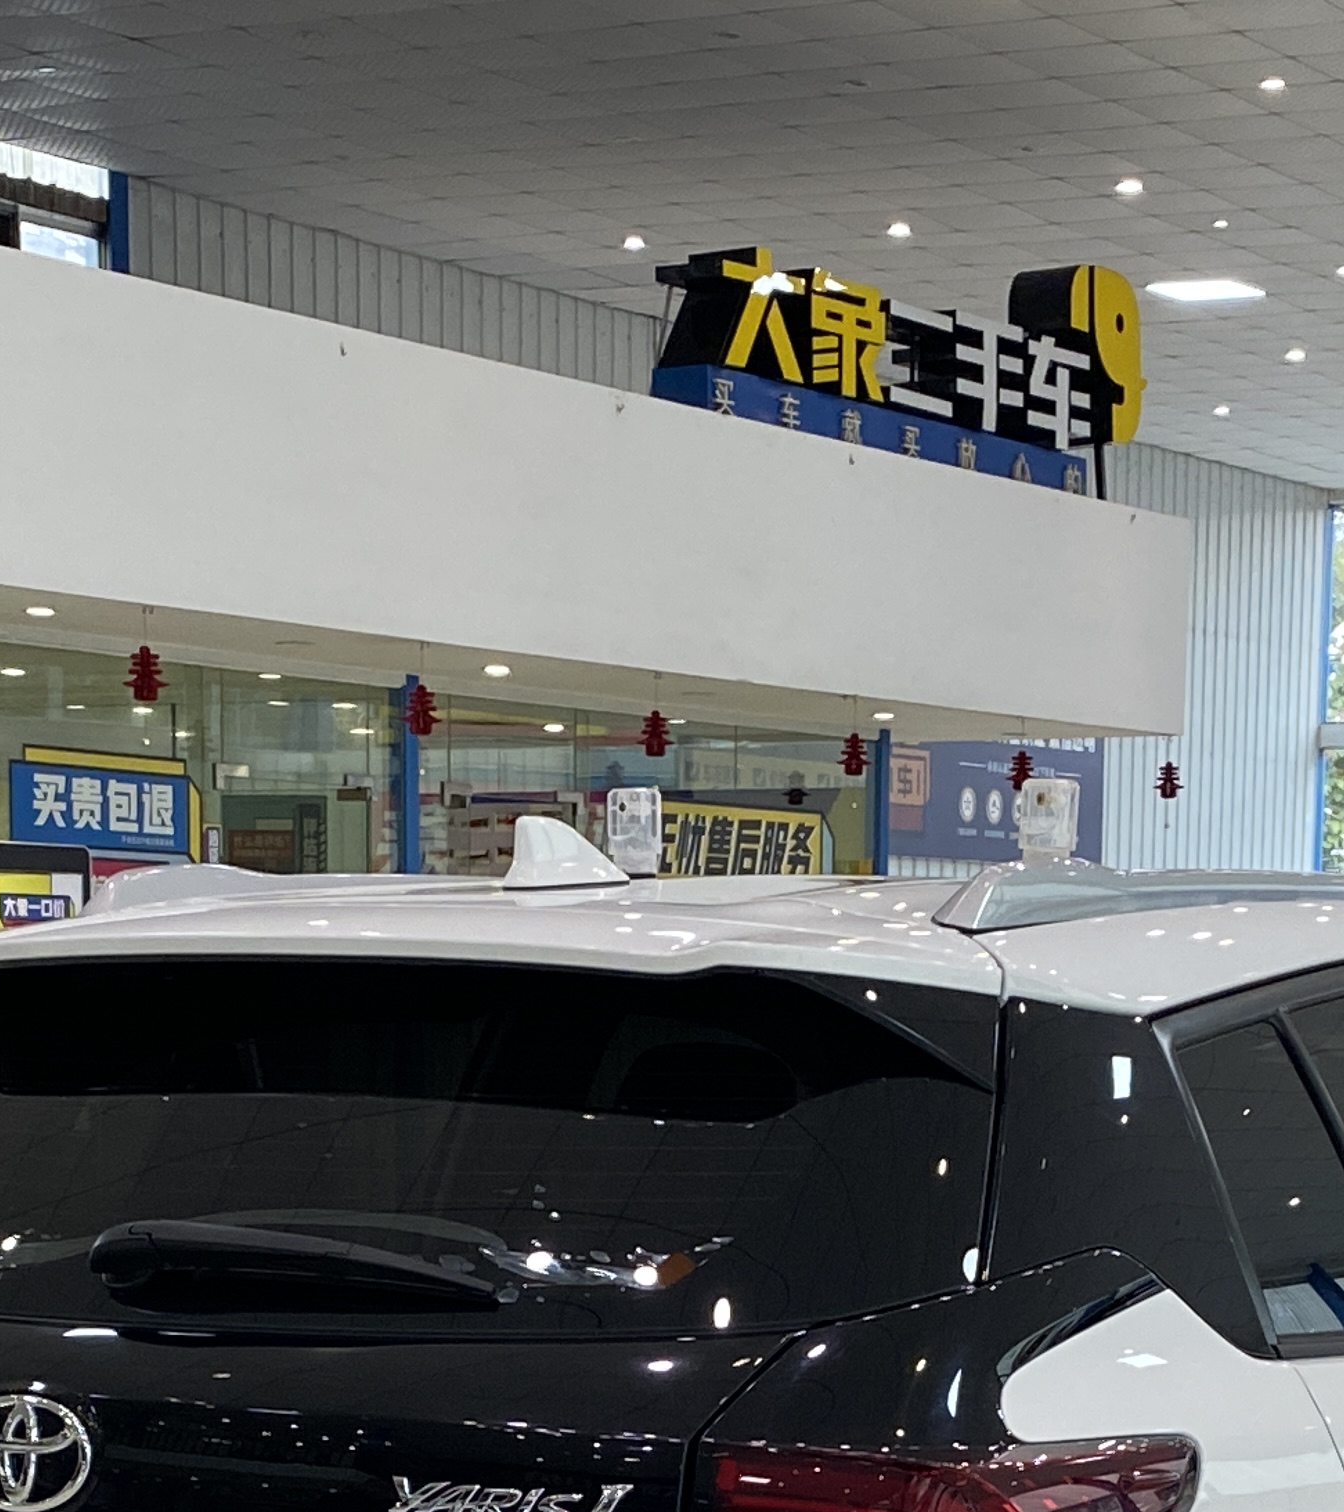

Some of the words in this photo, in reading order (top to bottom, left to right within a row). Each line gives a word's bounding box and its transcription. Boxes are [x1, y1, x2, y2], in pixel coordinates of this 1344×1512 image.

[722, 246, 1091, 450] 大象二手车
[33, 773, 175, 835] 买贵包退
